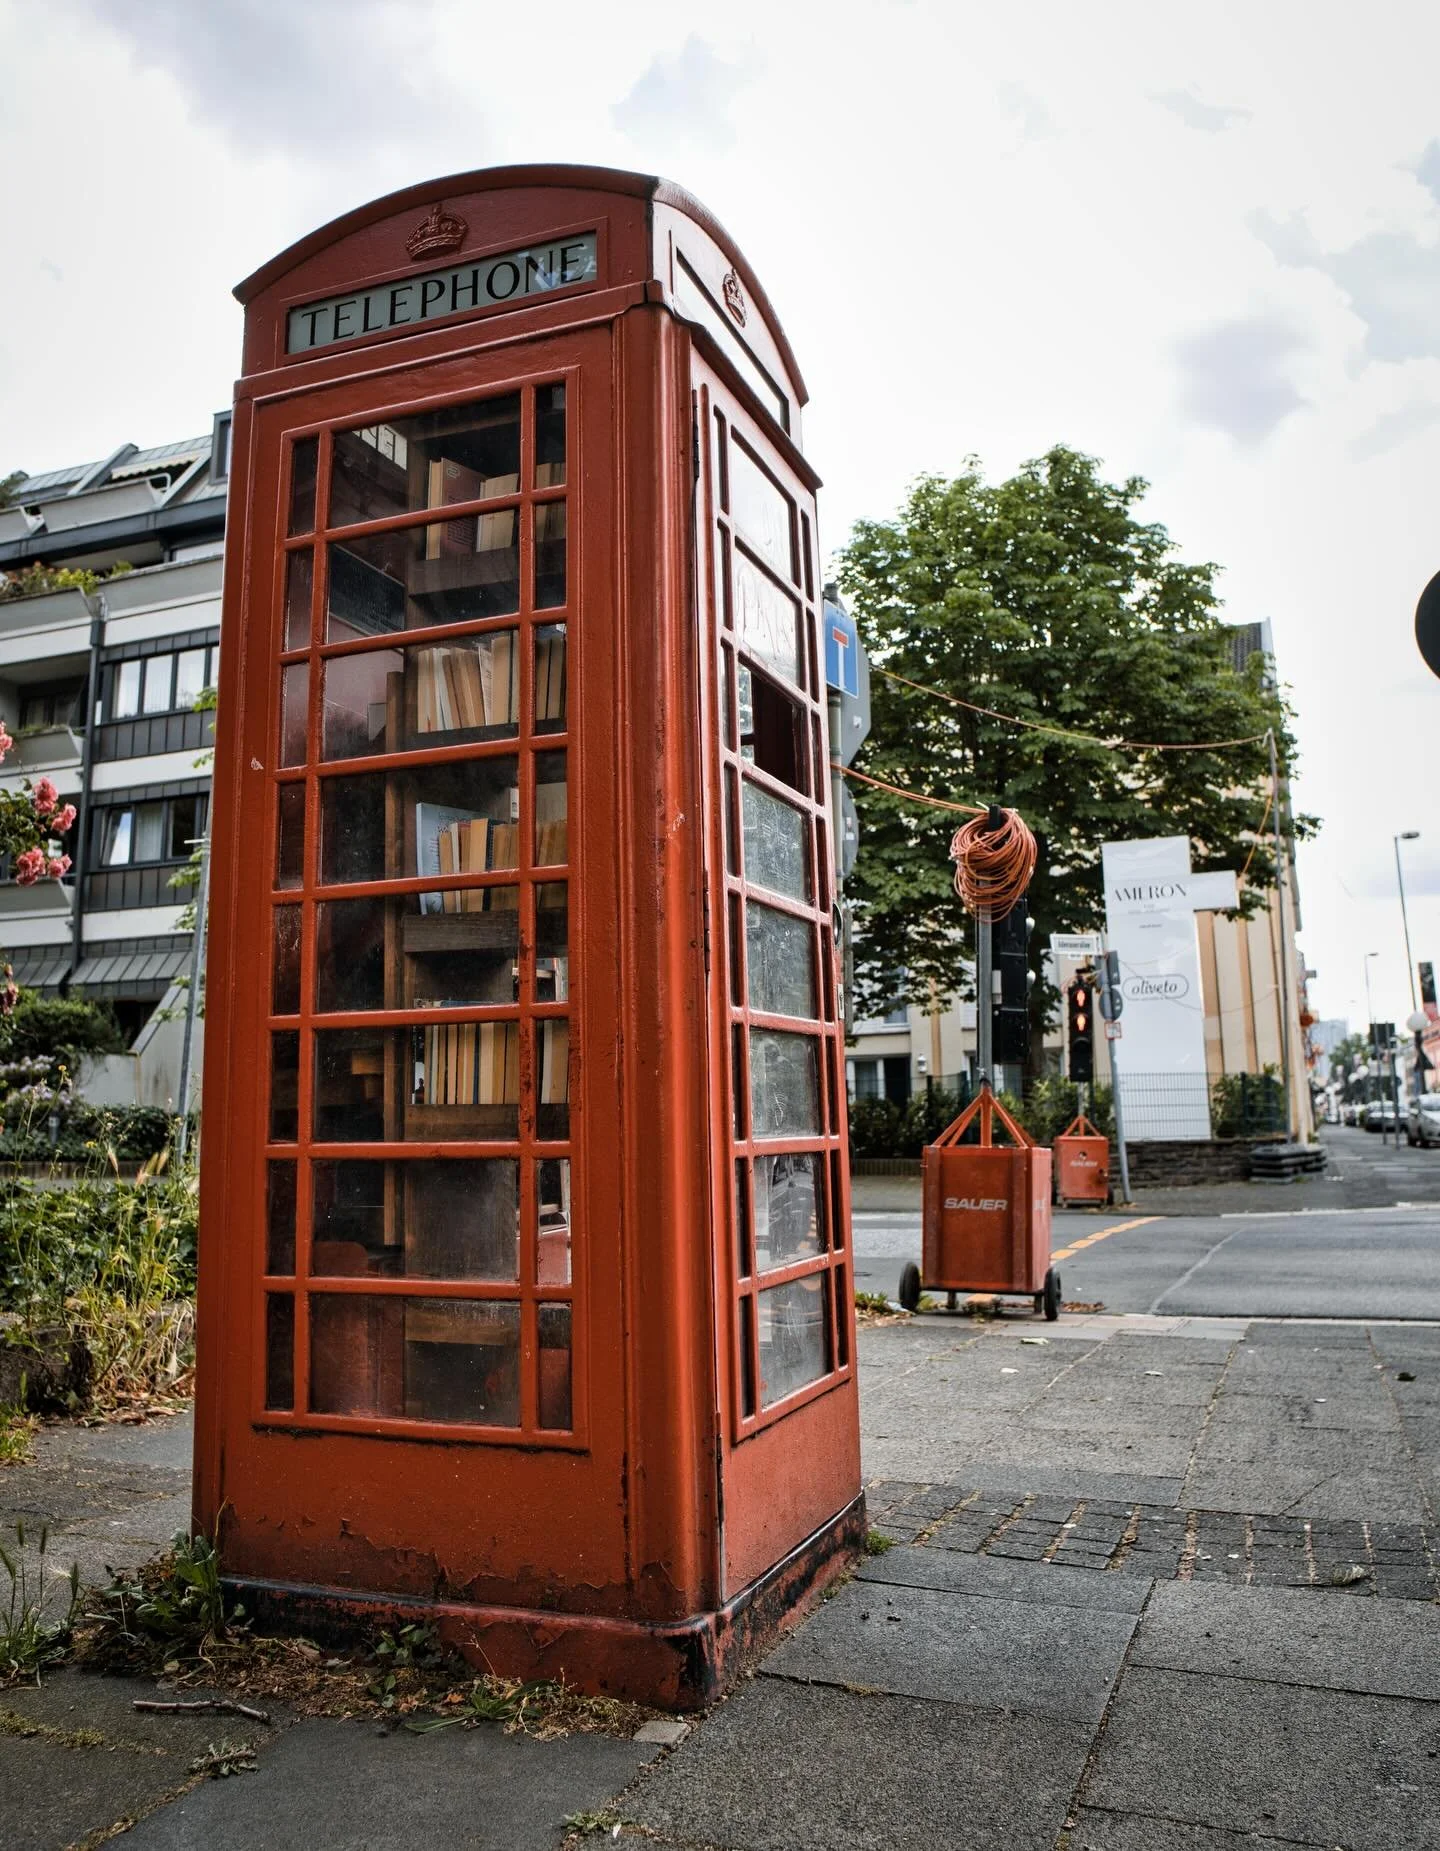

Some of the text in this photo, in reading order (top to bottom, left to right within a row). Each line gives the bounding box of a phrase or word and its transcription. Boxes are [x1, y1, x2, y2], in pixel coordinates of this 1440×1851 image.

[302, 243, 585, 346] TELEPHONE
[1131, 979, 1178, 995] oliveto
[944, 1198, 1008, 1211] SAUER
